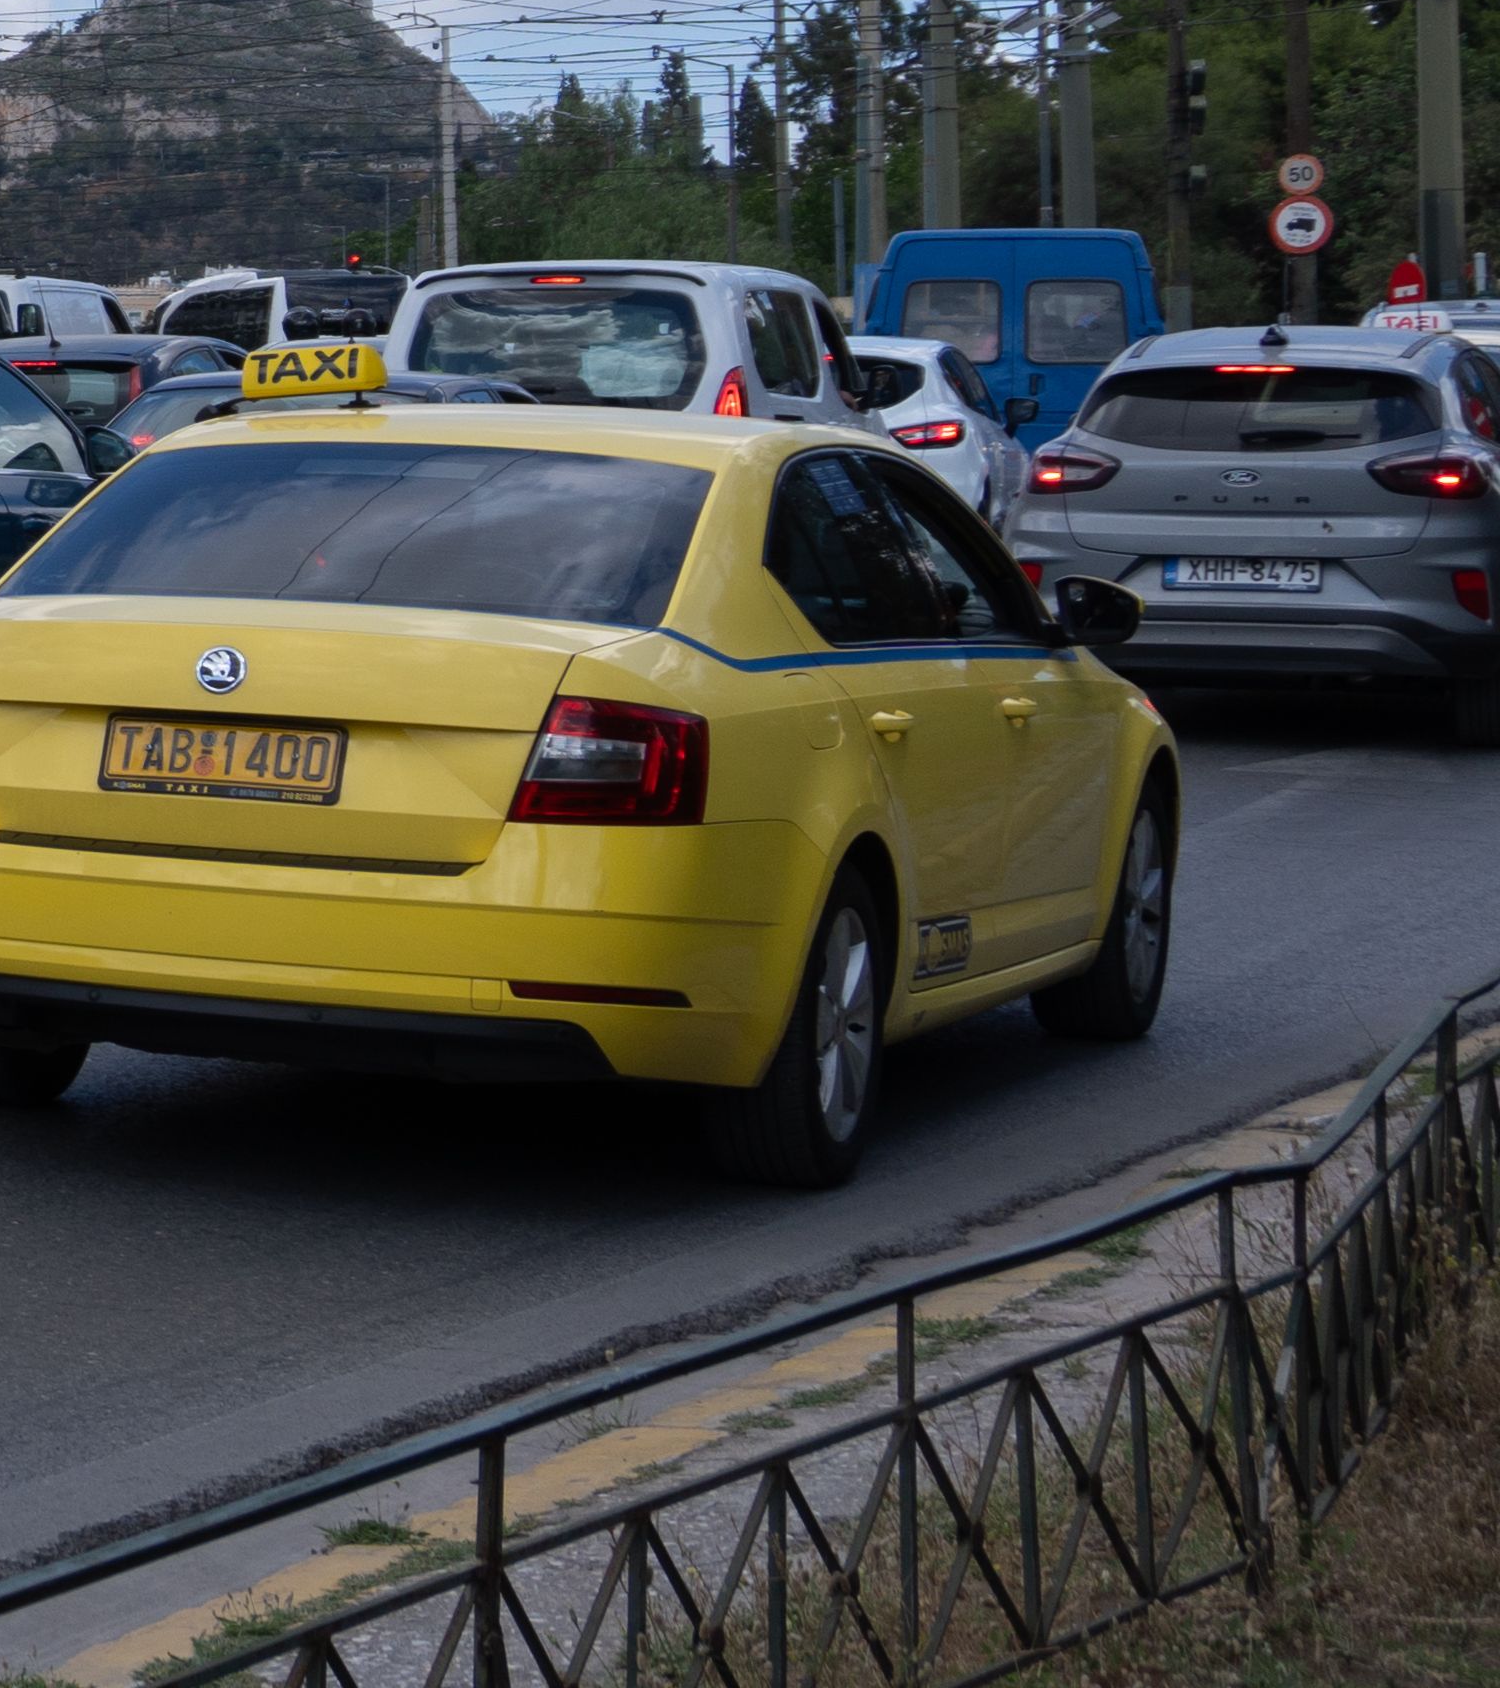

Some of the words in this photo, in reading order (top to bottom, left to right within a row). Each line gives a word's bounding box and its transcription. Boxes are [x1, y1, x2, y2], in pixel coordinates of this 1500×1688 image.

[1289, 166, 1314, 182] 50
[250, 347, 359, 384] TAXI
[1174, 495, 1310, 503] PUMA
[1188, 559, 1315, 582] XHH-8475
[165, 783, 209, 793] TAXI
